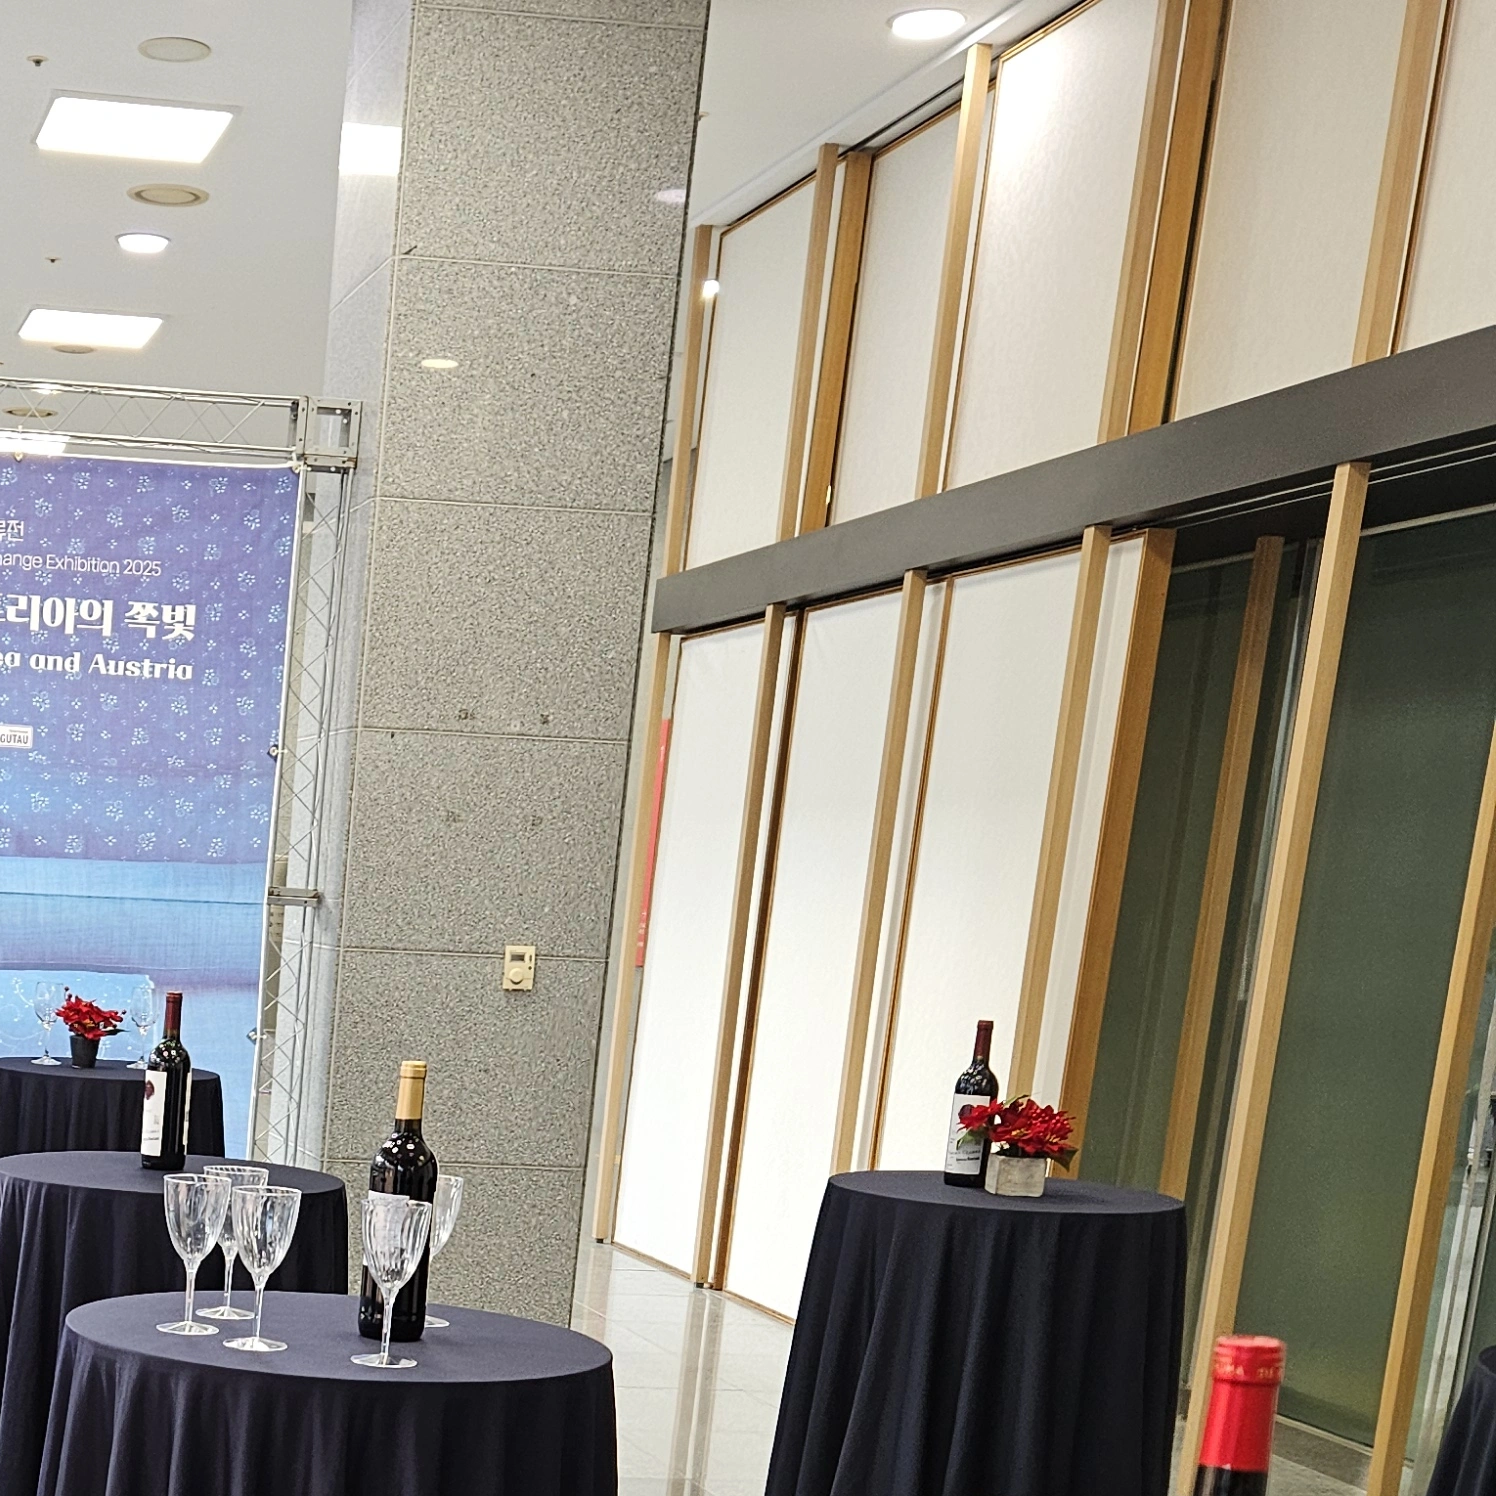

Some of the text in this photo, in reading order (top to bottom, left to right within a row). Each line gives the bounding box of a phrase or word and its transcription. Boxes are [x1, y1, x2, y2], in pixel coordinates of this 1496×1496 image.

[45, 554, 121, 574] Exhibition
[122, 558, 163, 577] 2025
[123, 600, 197, 641] 쪽빛
[29, 651, 81, 673] and
[88, 653, 194, 681] Austria
[0, 733, 29, 745] GUTAU
